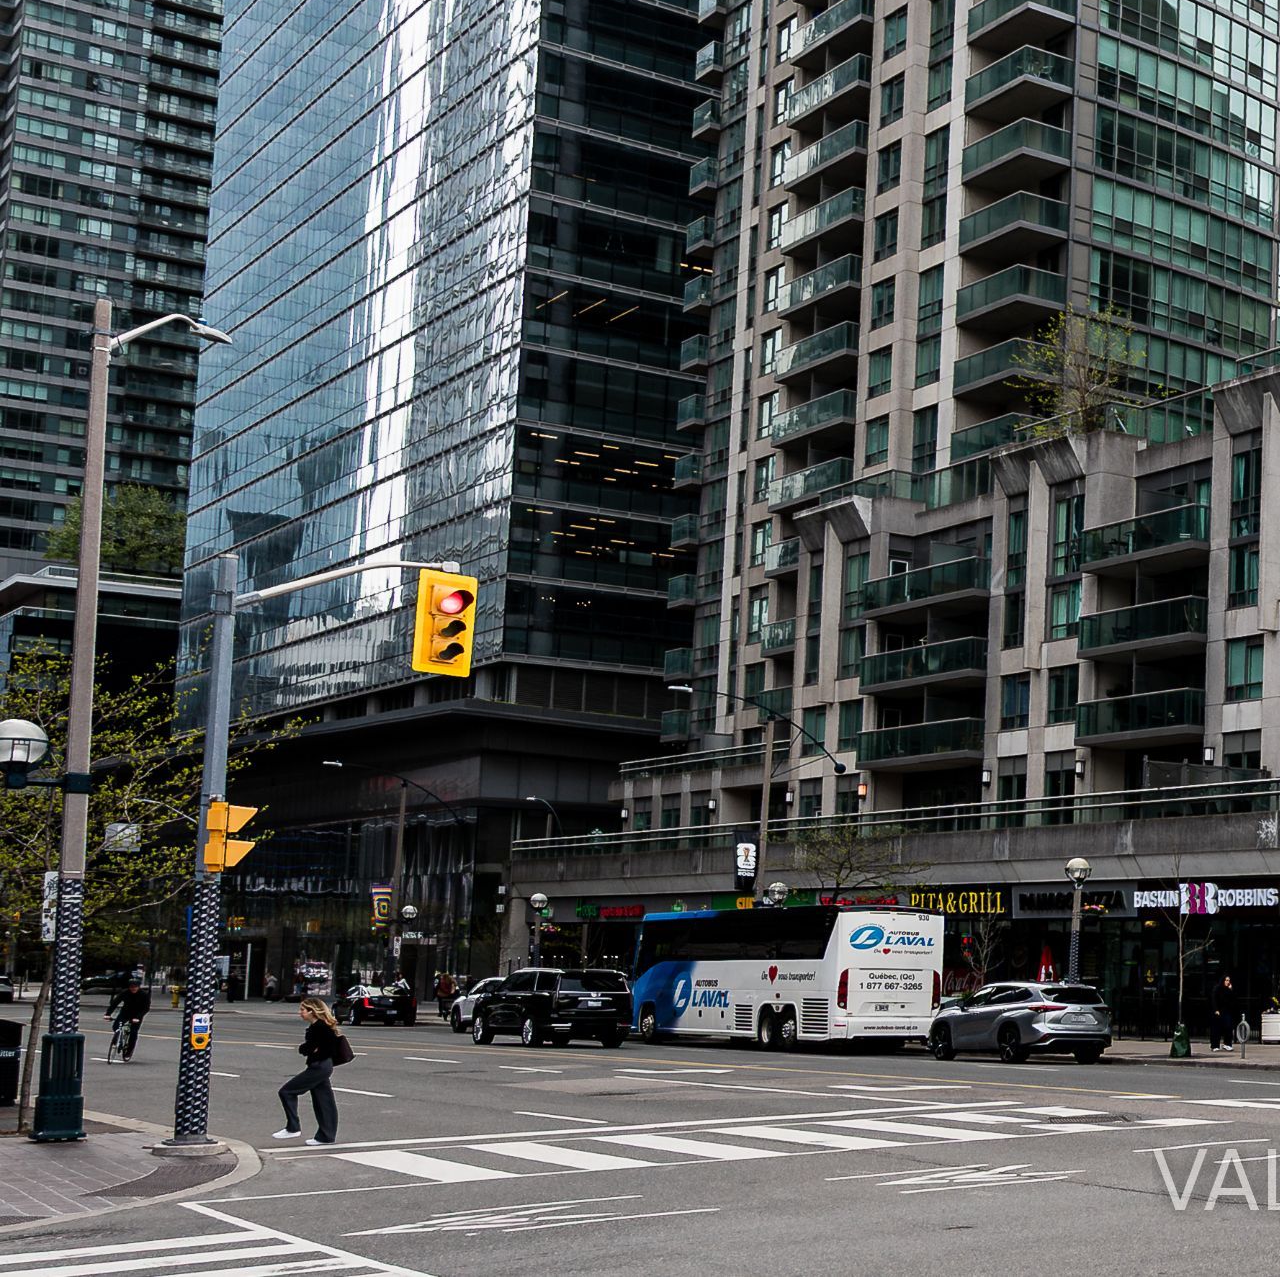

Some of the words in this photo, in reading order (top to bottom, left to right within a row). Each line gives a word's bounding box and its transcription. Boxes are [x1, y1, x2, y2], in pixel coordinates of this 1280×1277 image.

[1134, 890, 1180, 908] BASKIN
[1218, 888, 1279, 907] ROBBINS
[885, 936, 935, 947] LAVAL
[868, 972, 899, 981] Québec,
[899, 973, 915, 982] (Qc)
[694, 979, 719, 988] AUTOBUS
[884, 983, 923, 991] 667-3265
[691, 990, 730, 1008] LAVAL
